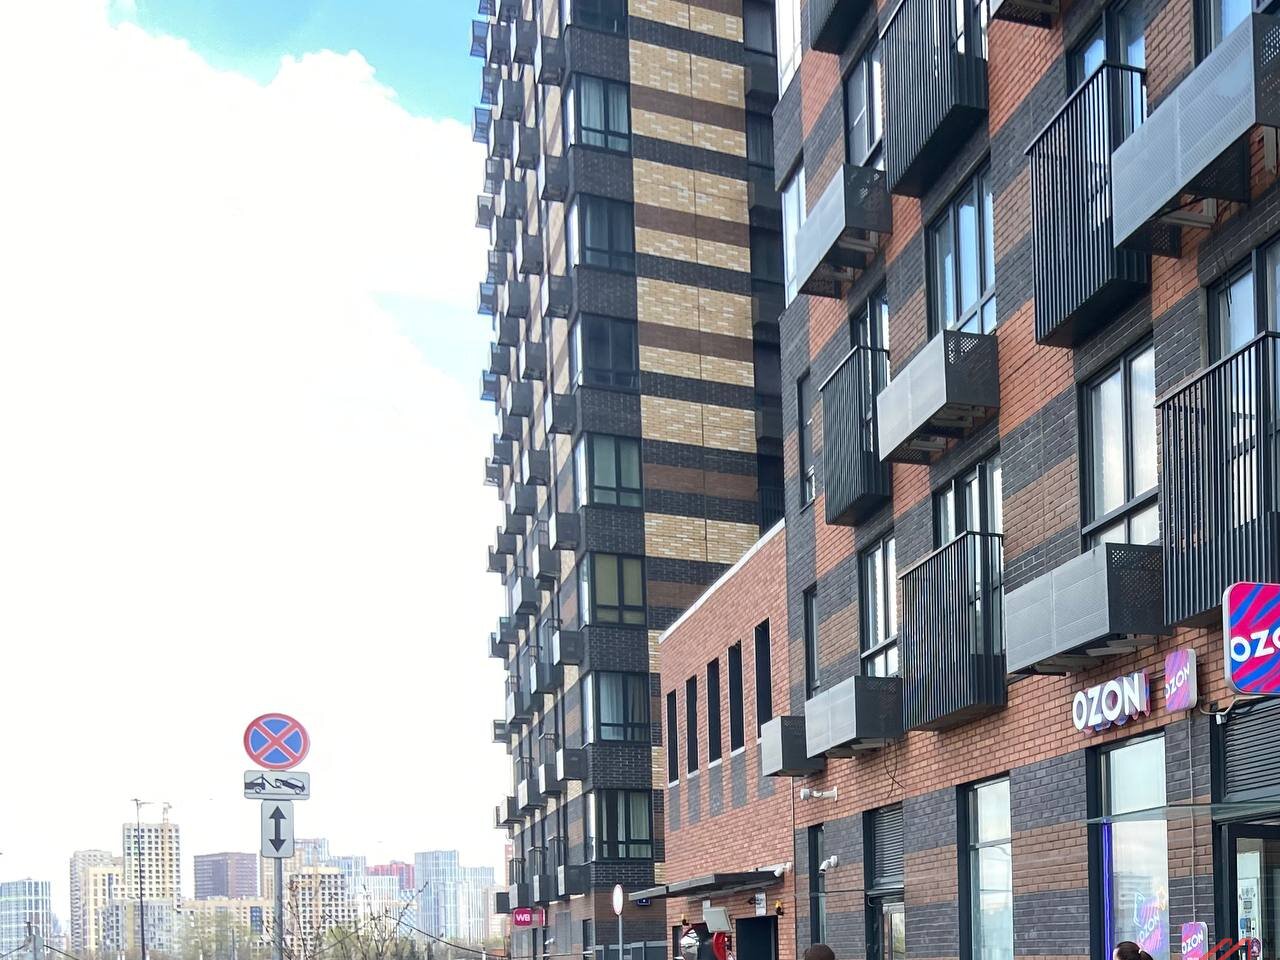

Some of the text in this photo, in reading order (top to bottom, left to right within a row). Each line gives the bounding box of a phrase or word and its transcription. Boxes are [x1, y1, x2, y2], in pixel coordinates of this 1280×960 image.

[1165, 662, 1189, 699] OZON
[1072, 672, 1140, 731] OZON
[515, 913, 531, 922] WB
[1181, 929, 1204, 955] OZON
